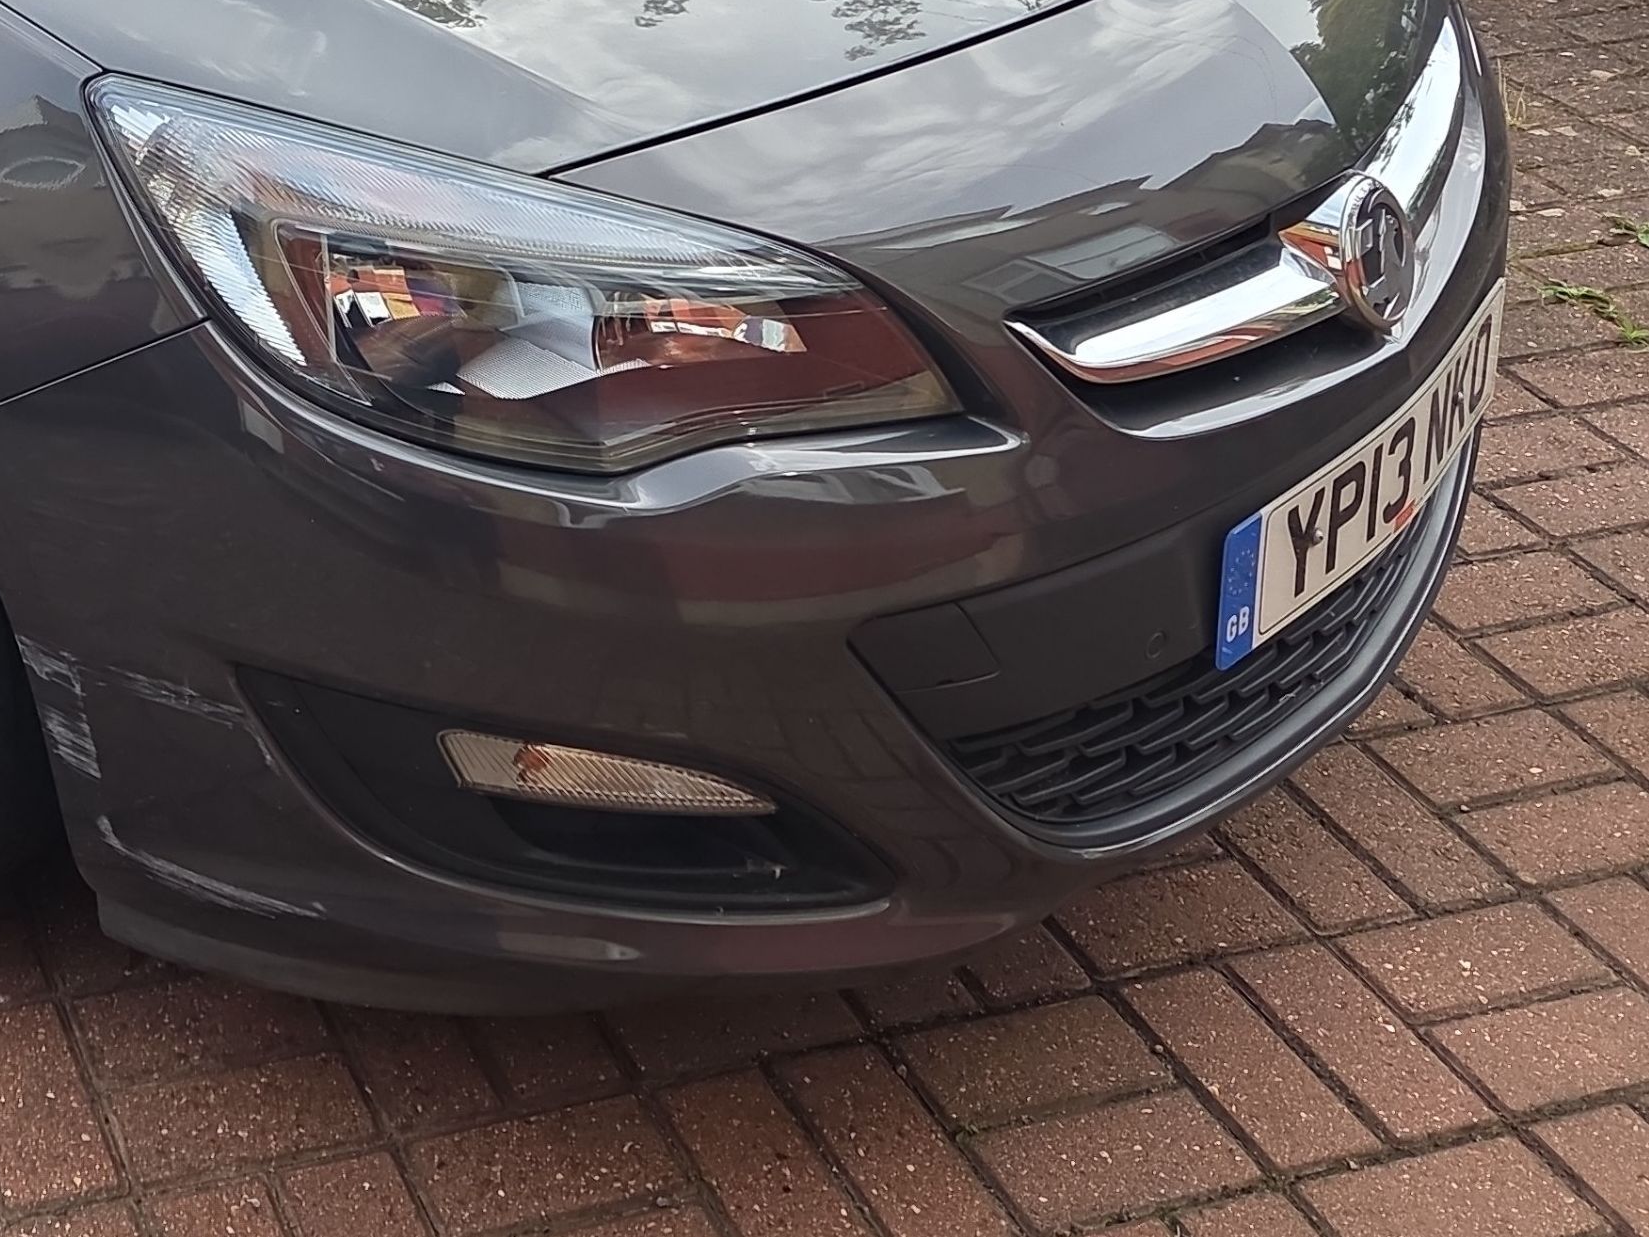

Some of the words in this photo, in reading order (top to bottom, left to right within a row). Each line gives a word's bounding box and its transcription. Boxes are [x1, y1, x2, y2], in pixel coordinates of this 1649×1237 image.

[1287, 417, 1416, 598] YP13
[1423, 314, 1492, 484] NKO
[1226, 606, 1250, 643] GB
